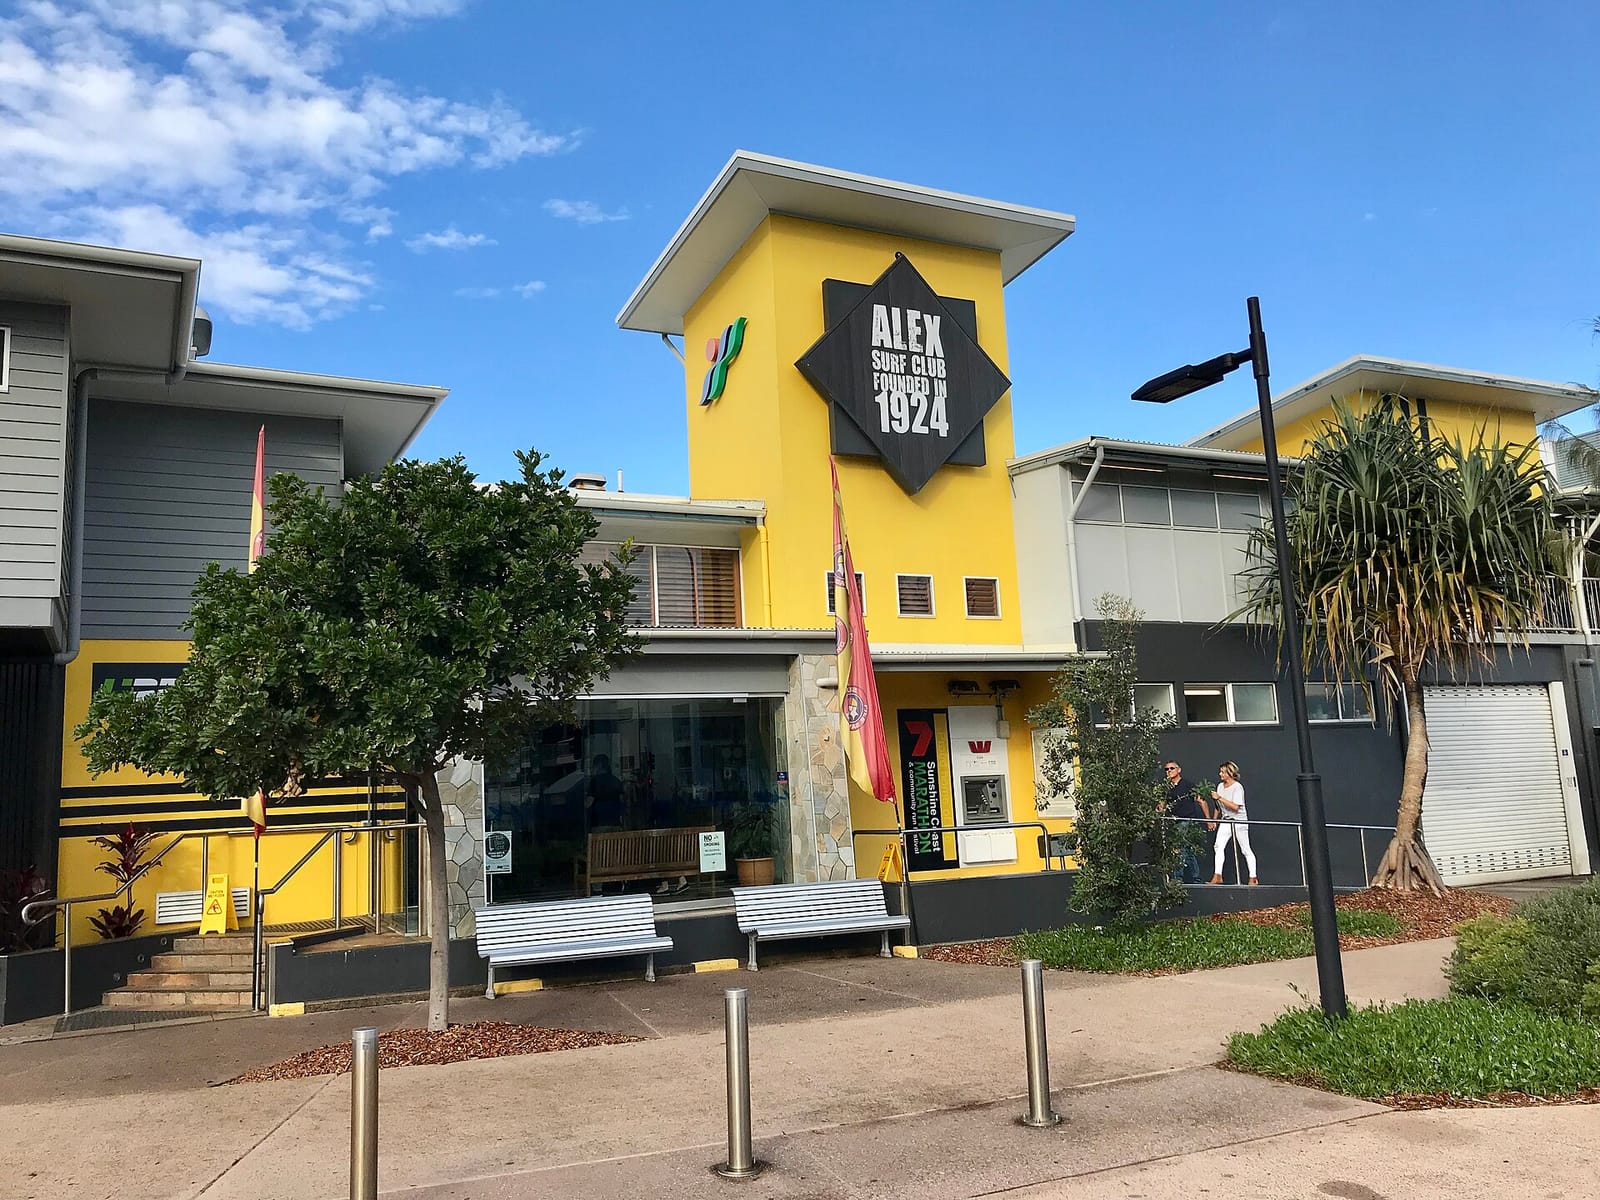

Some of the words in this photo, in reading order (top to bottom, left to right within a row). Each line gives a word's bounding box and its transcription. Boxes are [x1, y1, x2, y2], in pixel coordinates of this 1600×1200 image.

[872, 304, 944, 358] ALEX
[872, 349, 907, 374] SURF
[911, 354, 947, 379] CLUB
[872, 372, 930, 395] FOUNDED
[933, 378, 947, 398] IN
[874, 391, 949, 437] 1924
[909, 769, 917, 811] community
[927, 761, 938, 816] Sunshine
